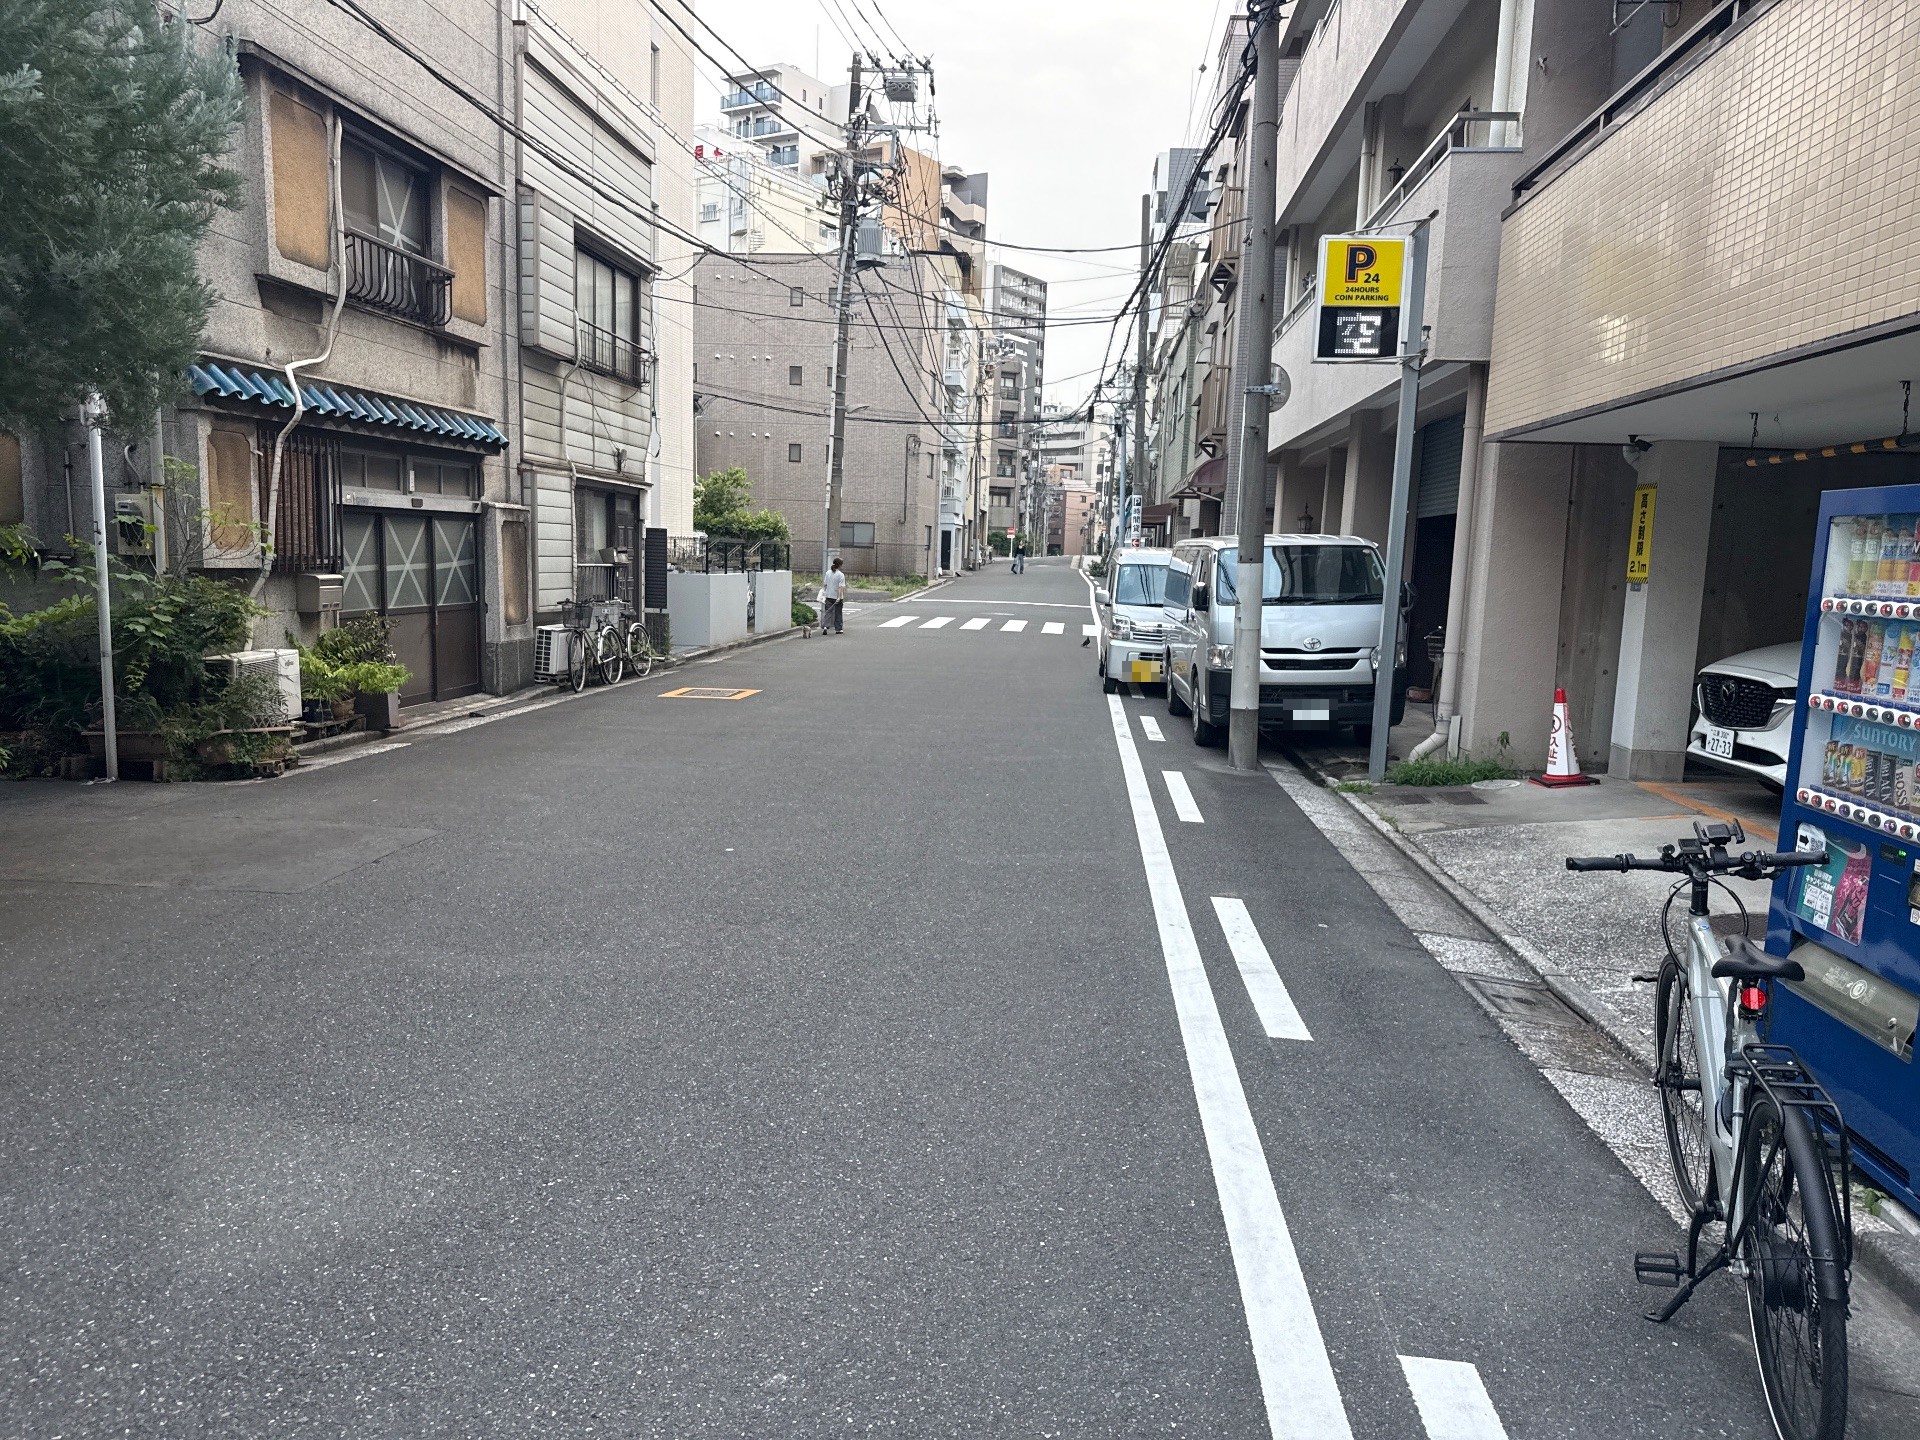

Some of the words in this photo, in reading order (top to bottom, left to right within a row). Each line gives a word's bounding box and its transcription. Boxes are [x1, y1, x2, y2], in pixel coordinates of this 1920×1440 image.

[1345, 244, 1377, 284] P
[1363, 273, 1380, 284] 24
[1355, 294, 1389, 302] PARKING
[1132, 508, 1141, 533] 時間貸
[1636, 492, 1649, 557] 高さ制限
[1629, 560, 1647, 574] 2.1m
[1854, 723, 1918, 752] SUNTORY
[1896, 771, 1908, 807] BOSS
